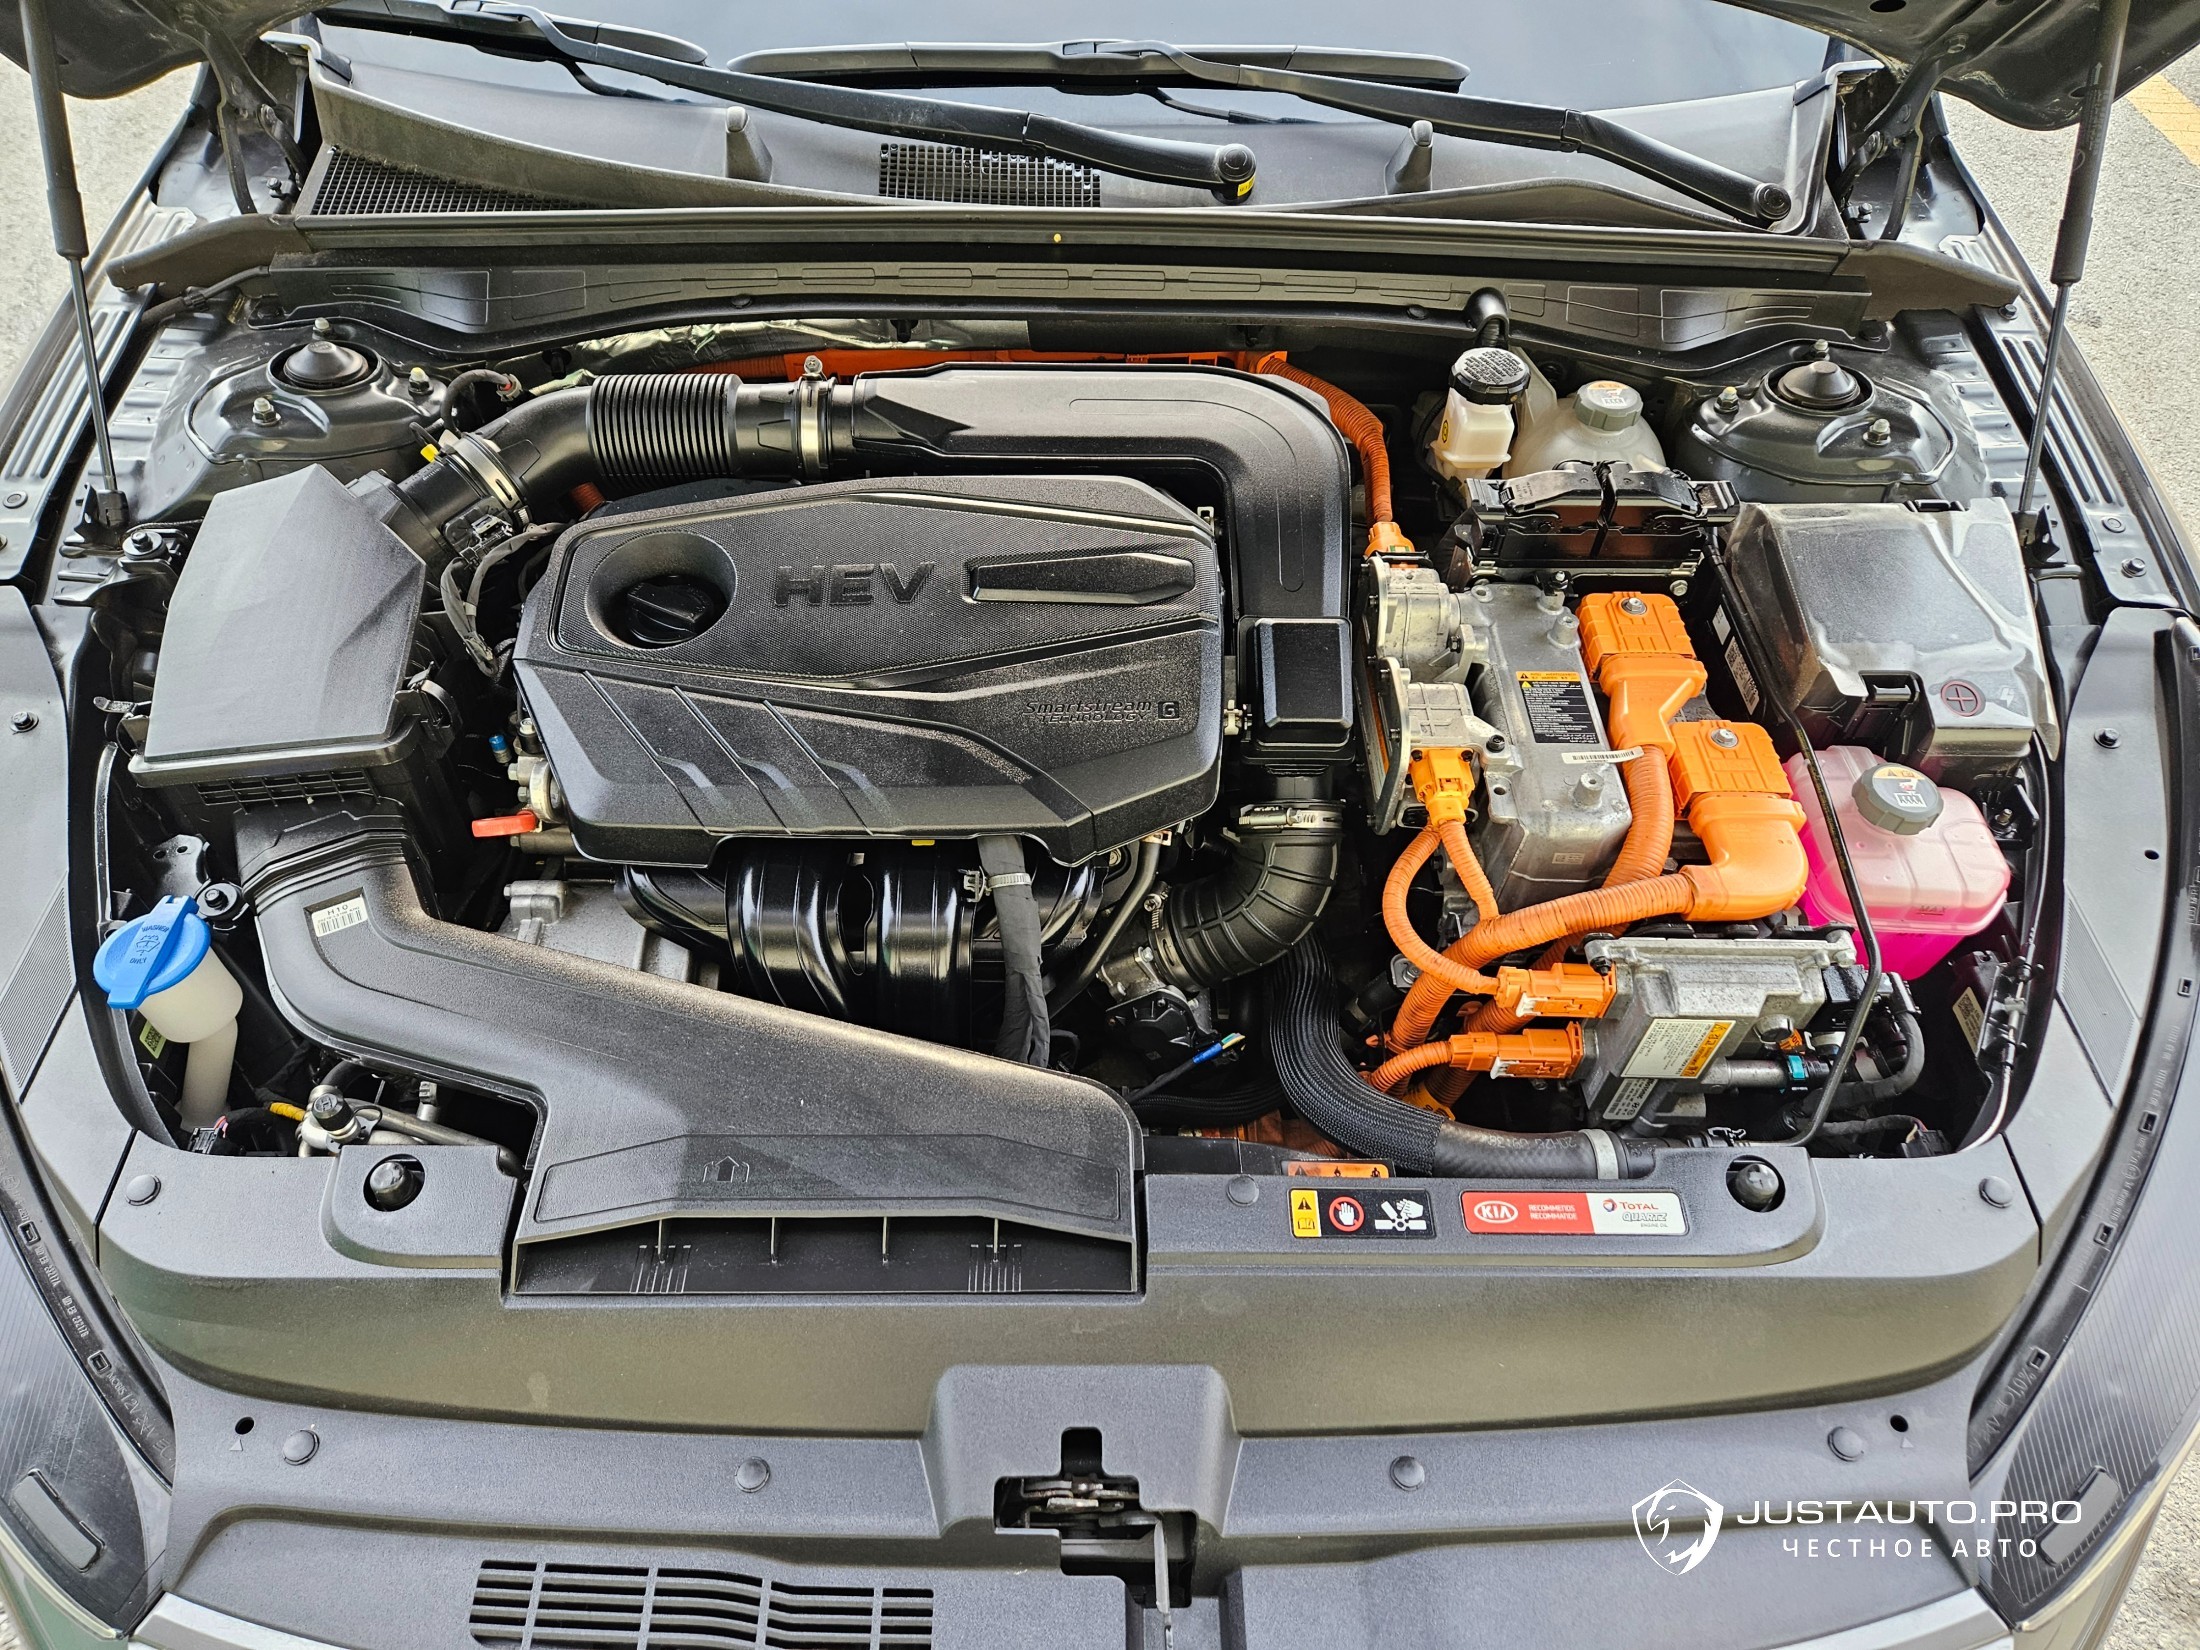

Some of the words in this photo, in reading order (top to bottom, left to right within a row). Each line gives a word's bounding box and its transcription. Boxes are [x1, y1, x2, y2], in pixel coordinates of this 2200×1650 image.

[775, 561, 935, 606] HEV
[1023, 700, 1152, 714] Smartstream
[1161, 702, 1176, 717] G
[1040, 713, 1149, 723] TECHNOLOGY
[141, 925, 170, 933] WASHER
[1528, 1204, 1575, 1212] RECOMMENDS
[1619, 1201, 1659, 1210] TOTAL
[1480, 1205, 1512, 1219] KIA
[1530, 1212, 1577, 1220] RECOMMANDE
[1622, 1211, 1668, 1222] QUARTZ
